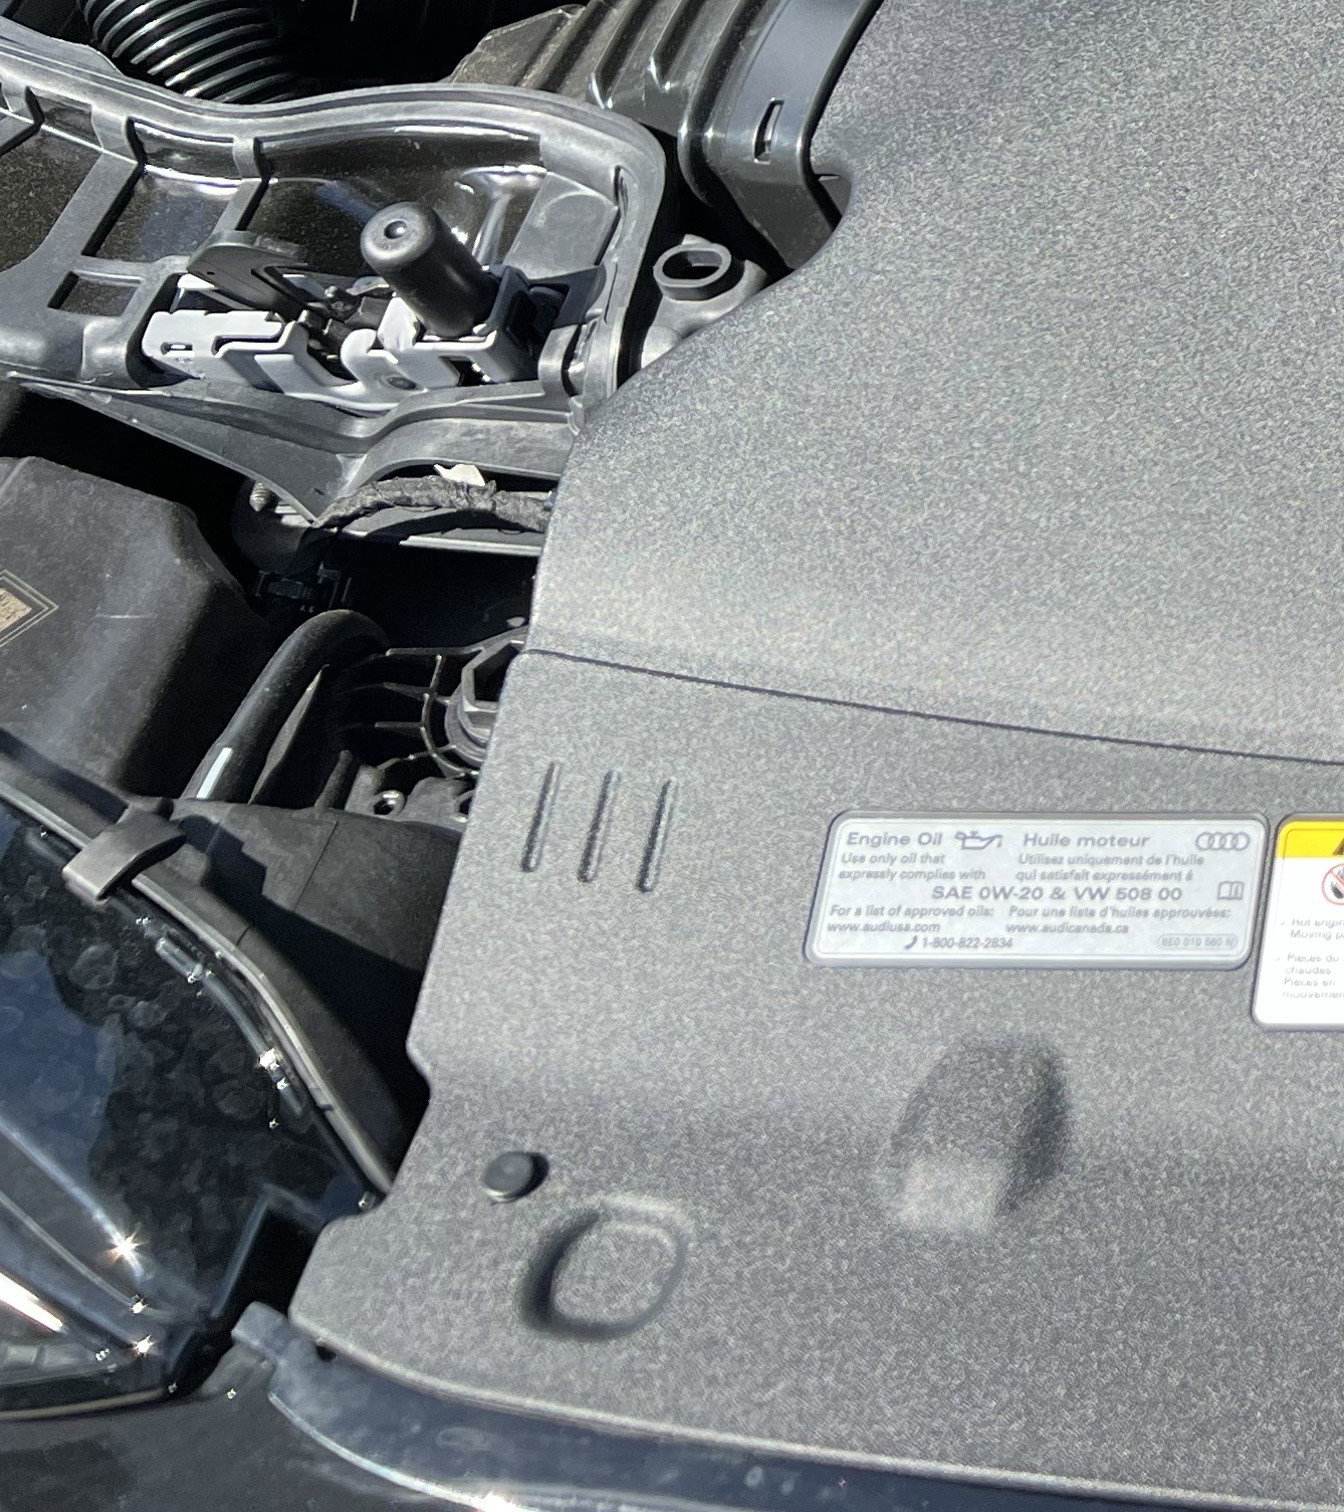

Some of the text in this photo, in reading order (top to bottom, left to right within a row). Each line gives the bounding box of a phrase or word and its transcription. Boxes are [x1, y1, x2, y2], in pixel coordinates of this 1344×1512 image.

[847, 832, 943, 848] Engine Oil
[1023, 833, 1150, 846] Huile moteur
[842, 853, 945, 866] Use only oil that
[1018, 854, 1064, 865] Utilisez
[1067, 855, 1143, 867] uniquement
[1147, 855, 1162, 865] de
[839, 870, 985, 881] expressly complies with
[1015, 870, 1037, 881] qui
[1040, 870, 1089, 880] satisfait
[932, 886, 1182, 900] SAE 0W-20 & VW 508 00
[830, 905, 994, 918] For a list of approved oils:
[1009, 906, 1039, 916] Pour
[1042, 909, 1065, 917] une
[1069, 906, 1095, 917] liste
[1100, 906, 1149, 917] d'huiles
[827, 922, 940, 932] www.audiusa.com
[1006, 923, 1129, 933] www.audicanada.ca
[1290, 930, 1332, 940] Moving
[923, 937, 1013, 948] 1-800-822-2834
[1326, 954, 1339, 962] du
